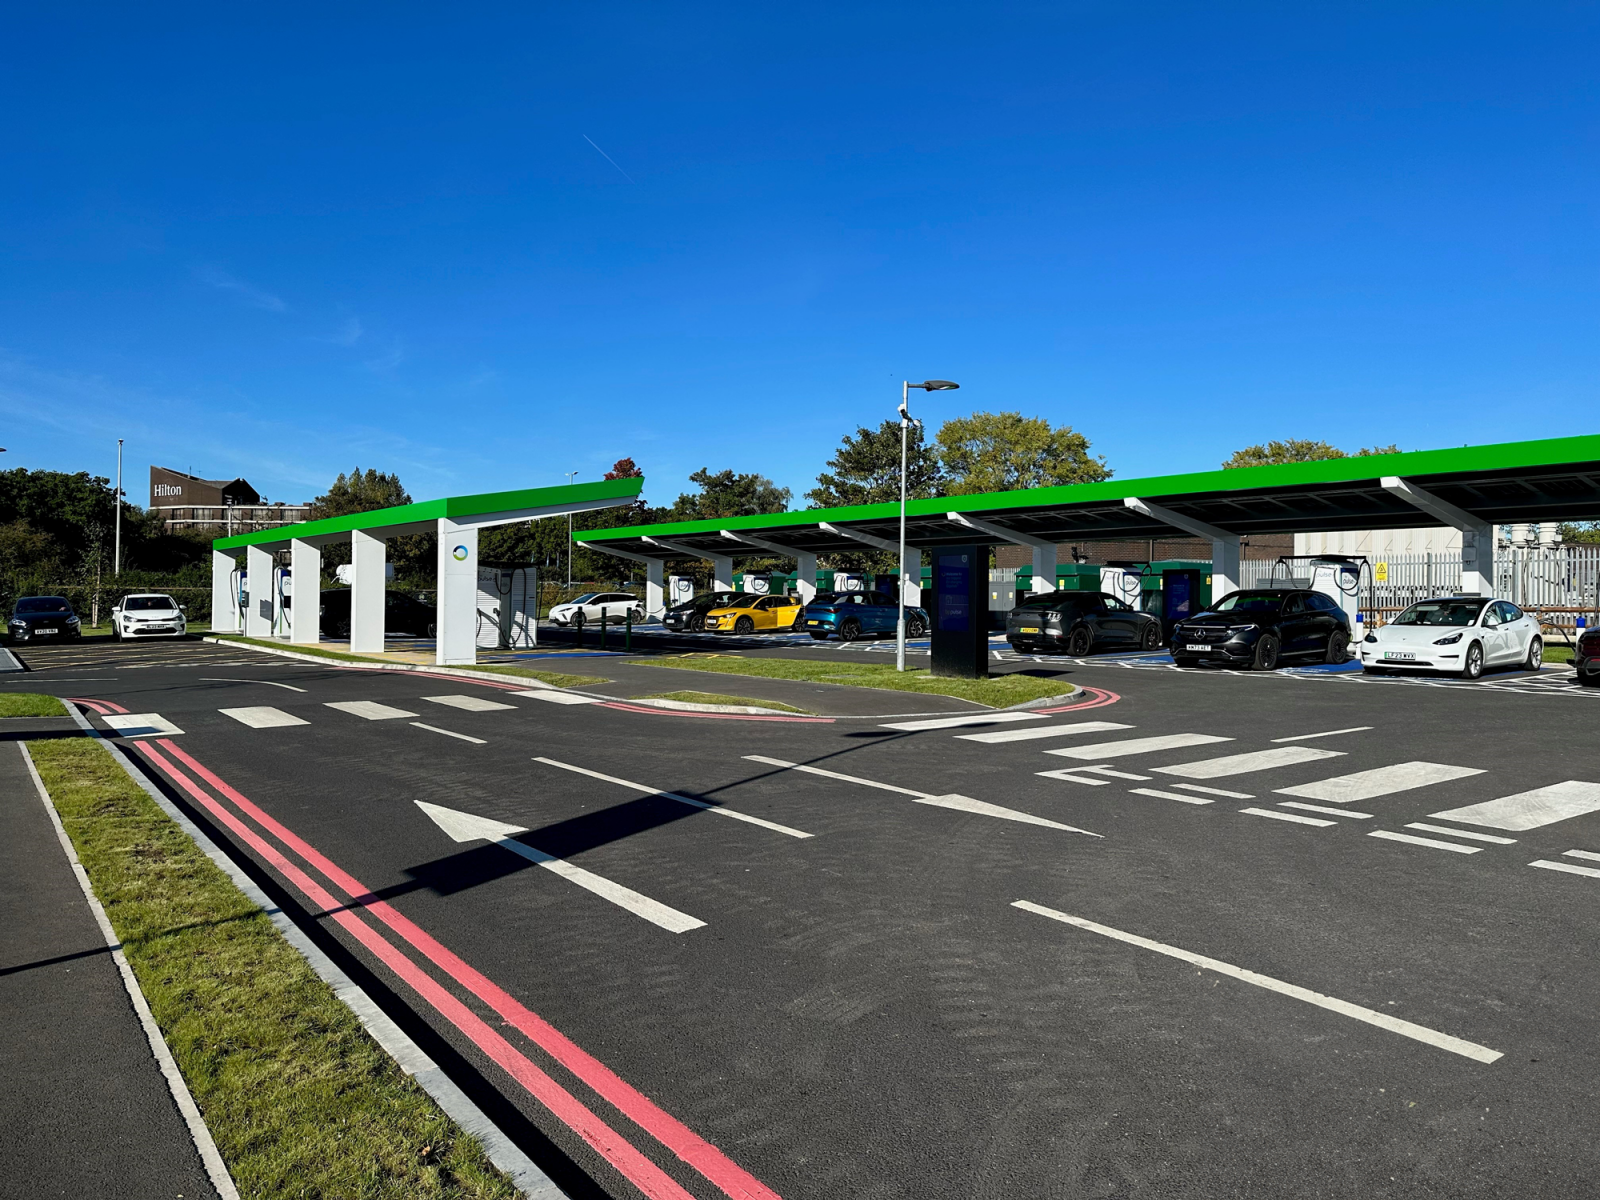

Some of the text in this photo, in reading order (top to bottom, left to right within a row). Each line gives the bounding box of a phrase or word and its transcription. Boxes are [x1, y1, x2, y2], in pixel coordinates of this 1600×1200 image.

[154, 484, 182, 497] Hilton
[1125, 578, 1137, 586] pulse
[1343, 577, 1355, 585] pulse
